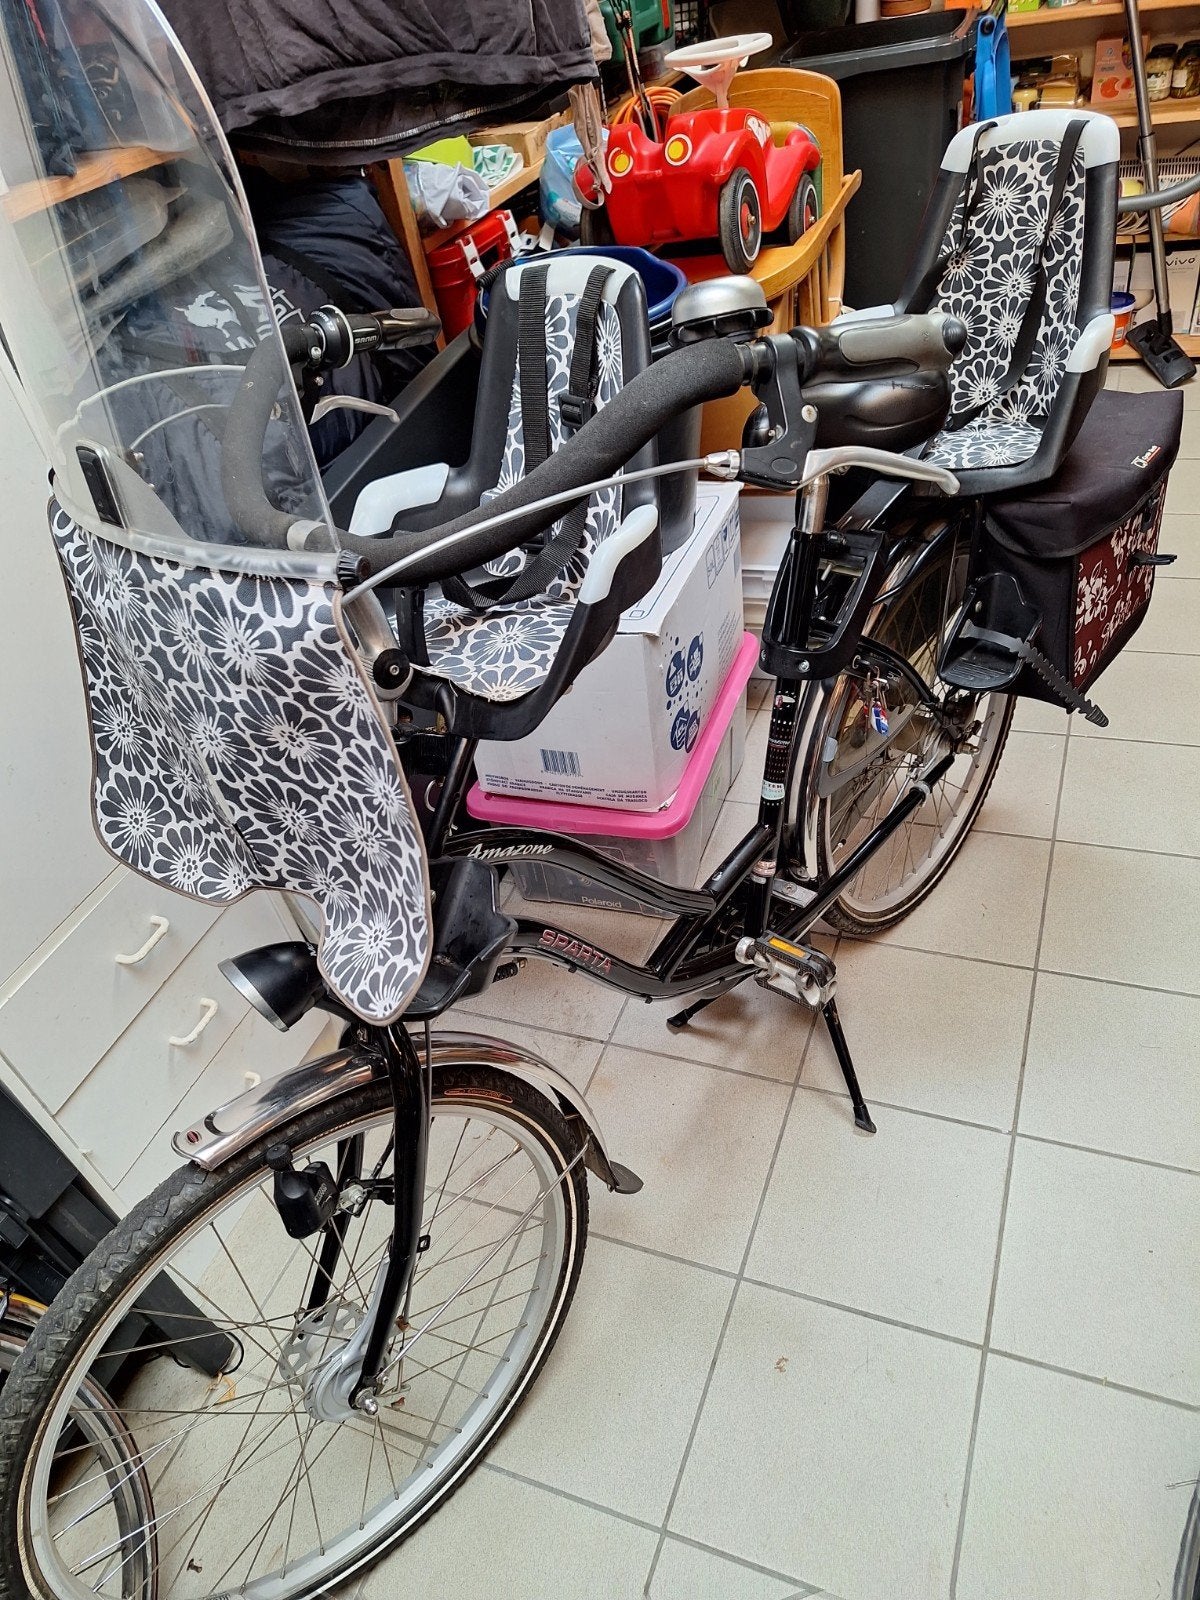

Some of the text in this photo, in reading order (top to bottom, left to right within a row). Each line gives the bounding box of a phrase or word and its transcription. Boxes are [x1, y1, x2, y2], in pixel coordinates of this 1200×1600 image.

[1165, 257, 1196, 267] vivo
[467, 843, 555, 860] Amazone
[581, 896, 622, 908] Polaroid
[539, 929, 612, 974] SPARTA
